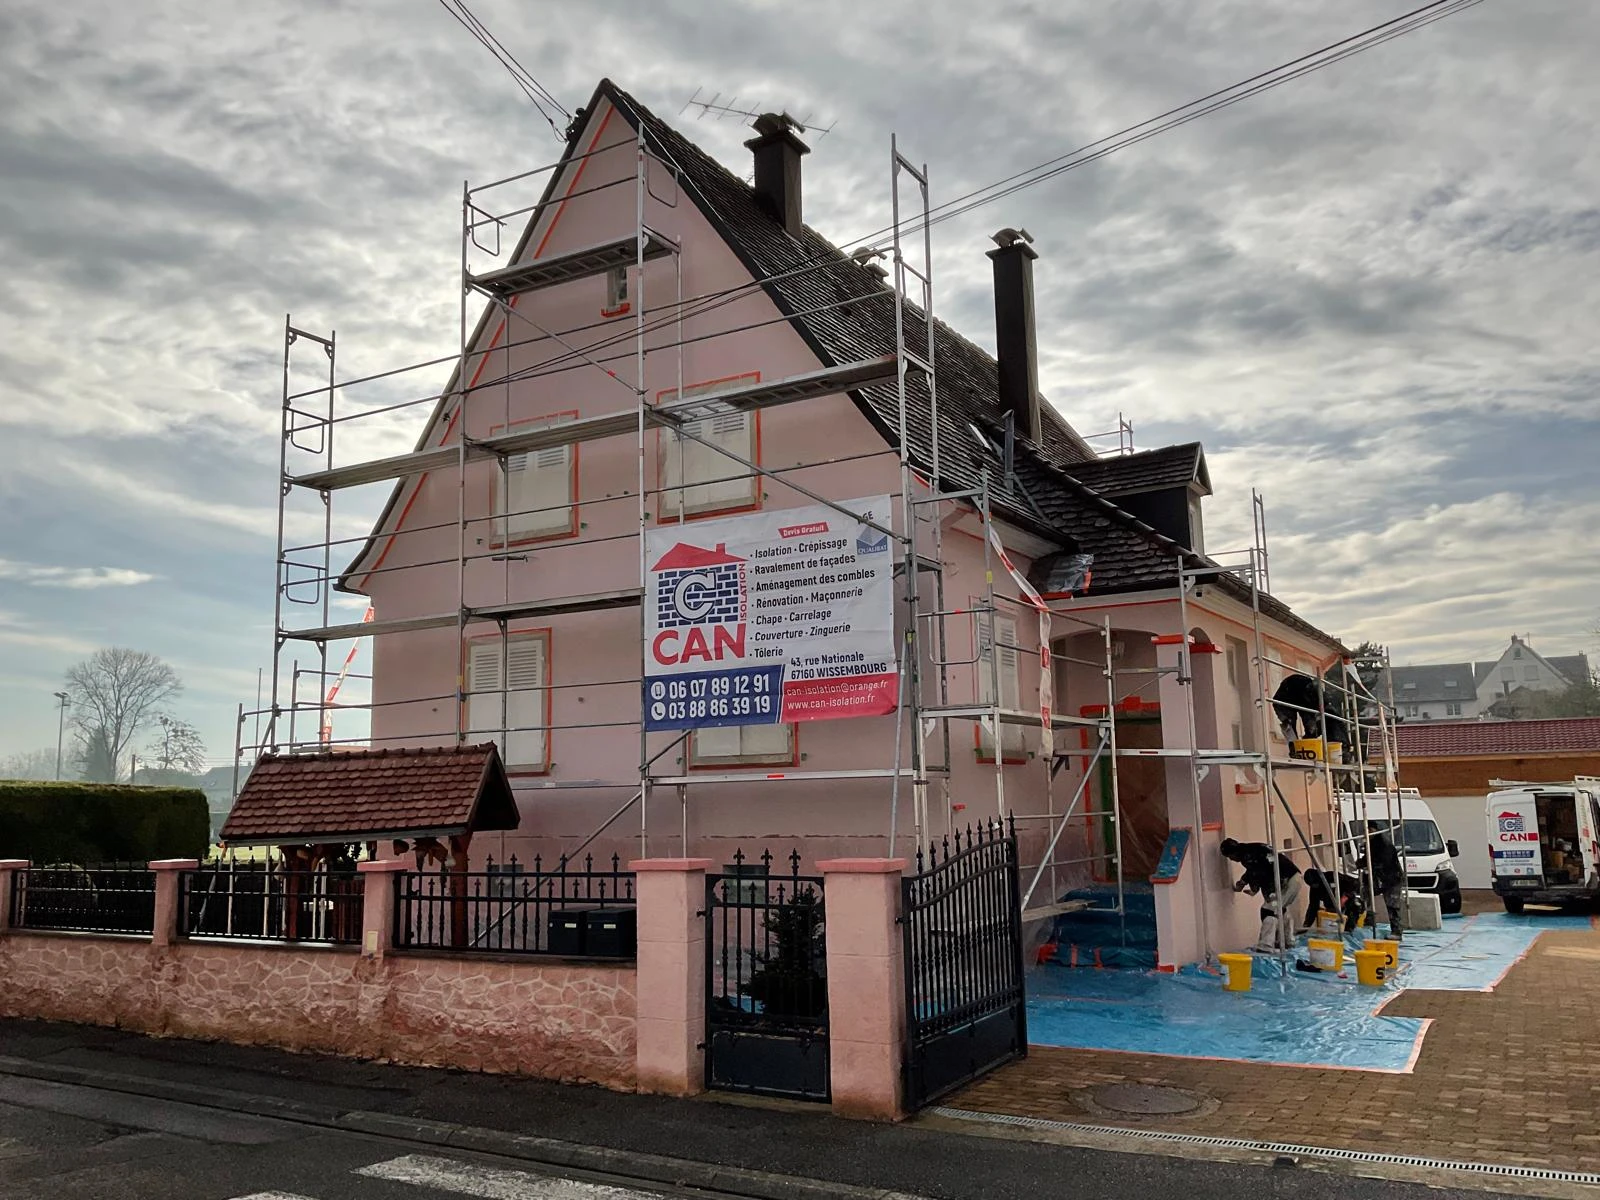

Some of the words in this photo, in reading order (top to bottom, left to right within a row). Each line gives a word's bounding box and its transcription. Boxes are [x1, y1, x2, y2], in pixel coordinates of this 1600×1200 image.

[783, 529, 800, 537] Devis
[801, 525, 824, 534] Gratuit
[755, 546, 792, 559] Isolation
[799, 539, 848, 553] Crépissage
[755, 560, 805, 575] Ravalement
[807, 559, 818, 568] de
[820, 554, 856, 568] façades
[756, 576, 817, 591] Aménagement
[819, 574, 835, 584] des
[838, 569, 875, 582] combles
[739, 563, 747, 621] ISOLATION
[756, 594, 803, 608] Rénovation
[811, 587, 863, 603] Maçonnerie
[756, 615, 782, 626] Chape
[789, 610, 832, 621] Carrelage
[755, 629, 803, 641] Couverture
[810, 622, 851, 637] Zinguerie
[653, 623, 746, 665] CAN
[754, 646, 783, 658] Tôlerie
[790, 657, 803, 668] 43,
[805, 656, 820, 666] rue
[822, 652, 864, 664] Nationale
[791, 669, 814, 680] 67160
[815, 662, 887, 678] WISSEMBOURG
[669, 681, 687, 699] 06
[690, 679, 707, 697] 07
[711, 677, 730, 696] 89
[733, 675, 750, 694] 12
[753, 674, 769, 693] 91
[787, 680, 888, 696] can-isolation@orange.fr
[668, 702, 686, 720] 03
[689, 700, 706, 718] 88
[710, 698, 728, 716] 86
[732, 697, 750, 715] 39
[753, 695, 770, 714] 19
[787, 693, 876, 710] www.can-isolation.fr
[1500, 833, 1527, 841] CAN
